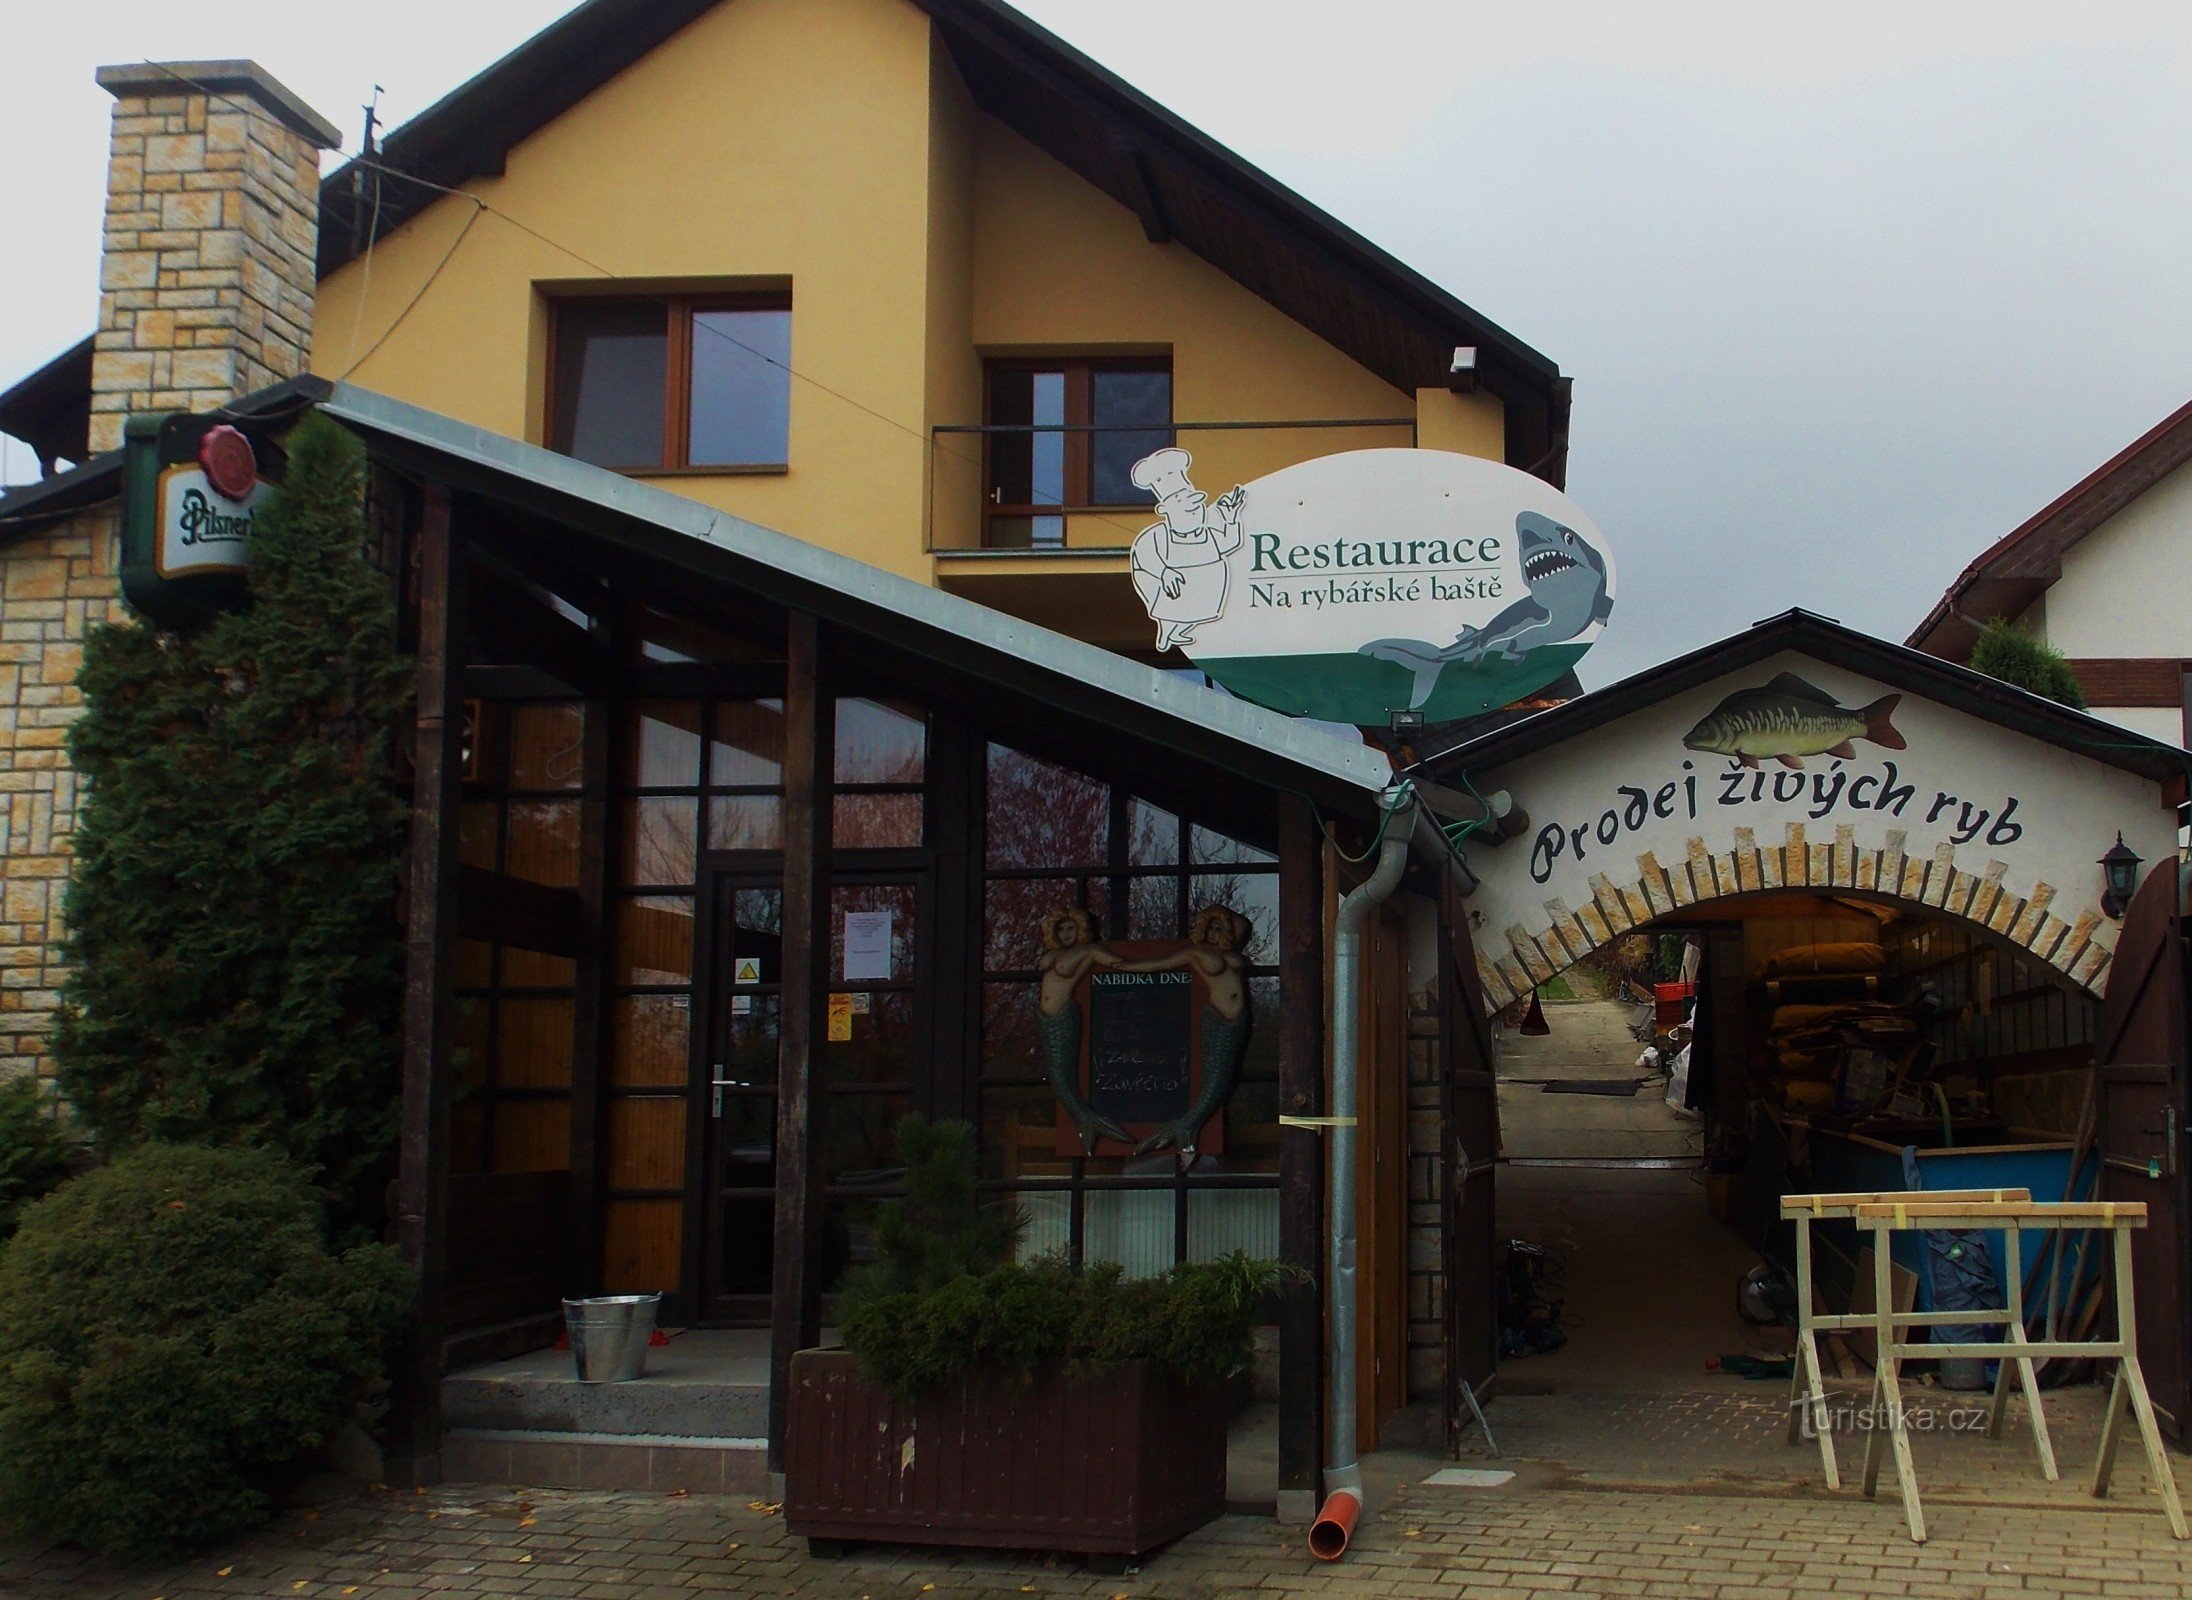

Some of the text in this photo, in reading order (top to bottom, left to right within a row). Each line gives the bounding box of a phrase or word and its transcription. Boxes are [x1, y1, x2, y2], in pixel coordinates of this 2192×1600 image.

[180, 488, 250, 545] Pilsner
[1250, 533, 1501, 572] Restaurace
[1250, 574, 1503, 610] Na rybářské baště
[1530, 759, 2024, 883] Prodej živých ryb
